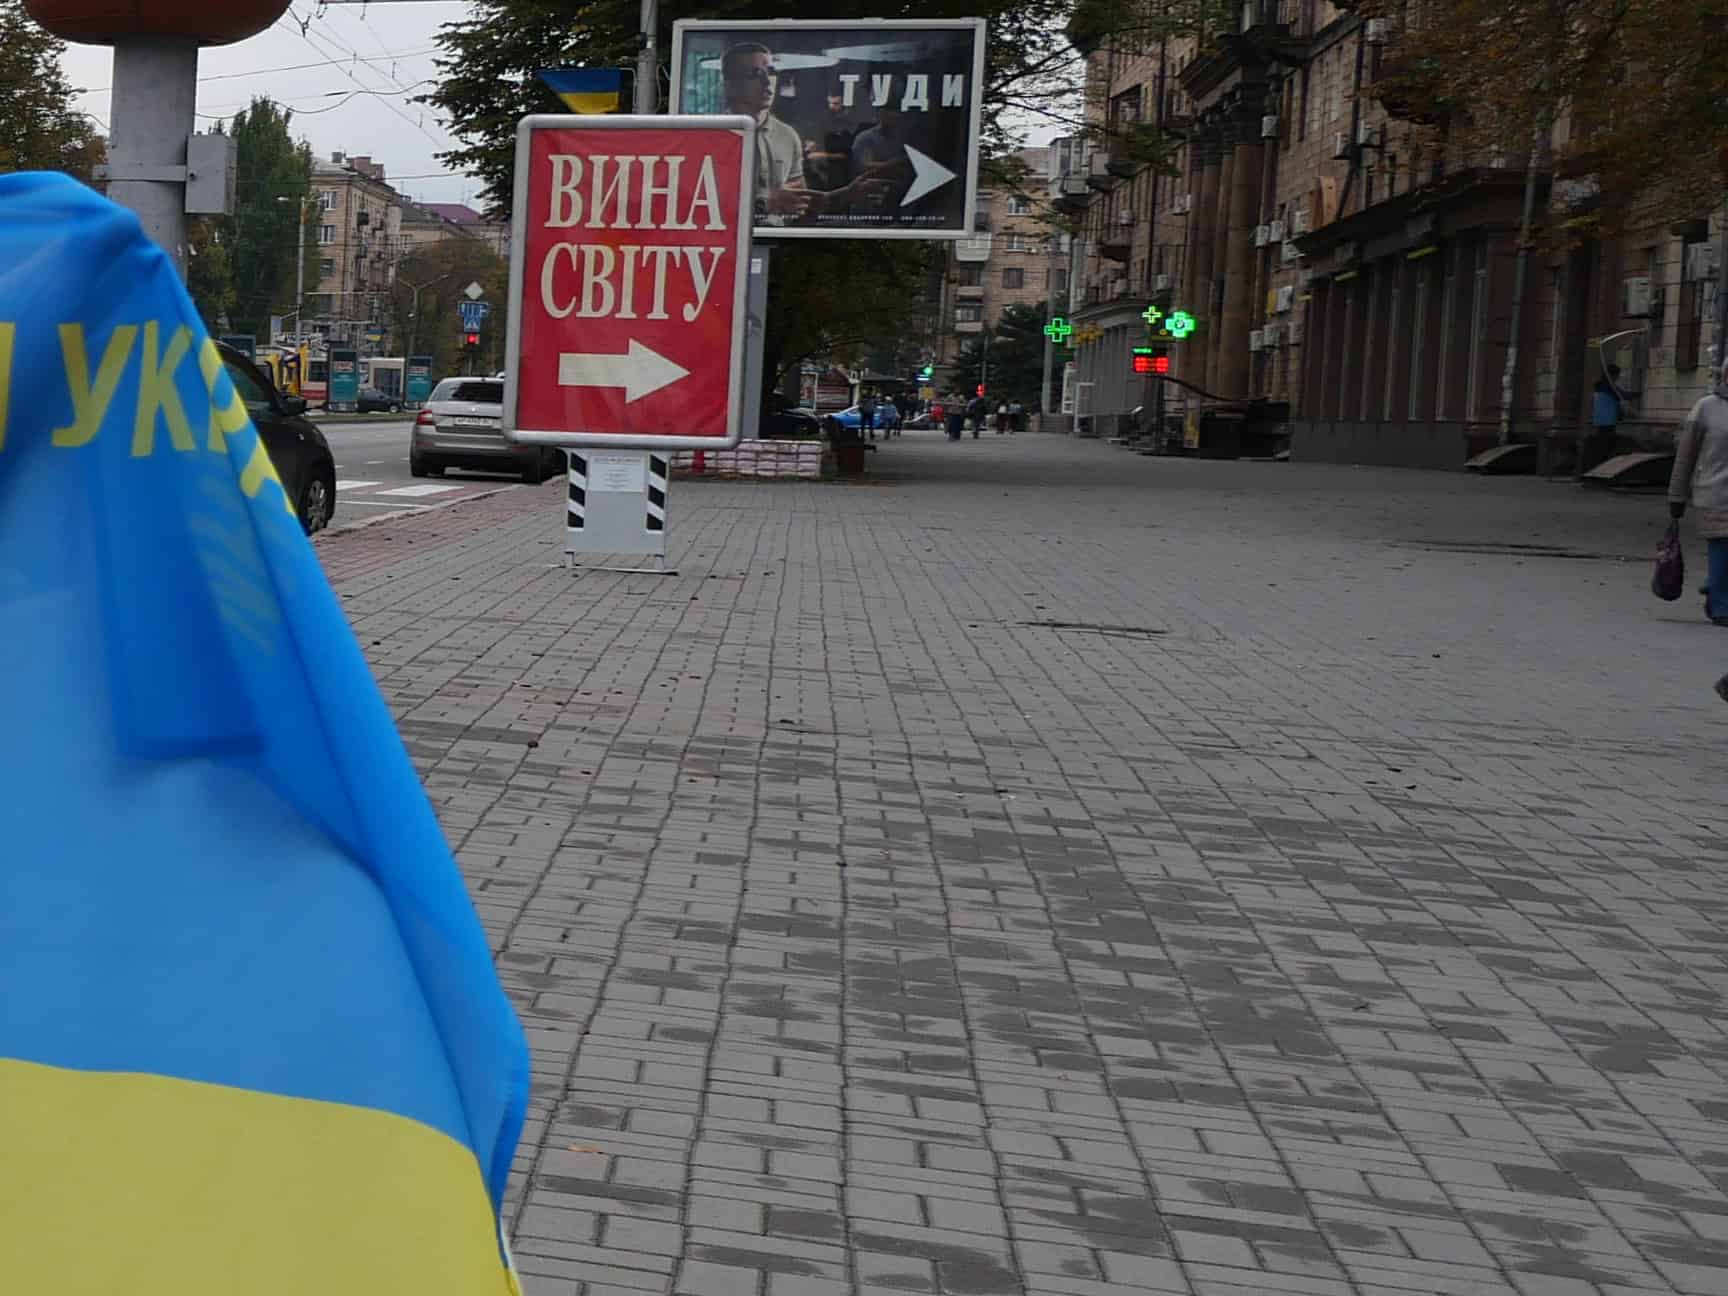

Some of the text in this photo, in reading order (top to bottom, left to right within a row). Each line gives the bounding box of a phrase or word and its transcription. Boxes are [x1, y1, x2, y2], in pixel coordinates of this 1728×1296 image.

[839, 74, 964, 112] ТУДИ
[544, 154, 727, 231] ВИНА
[540, 242, 726, 322] СВІТУ
